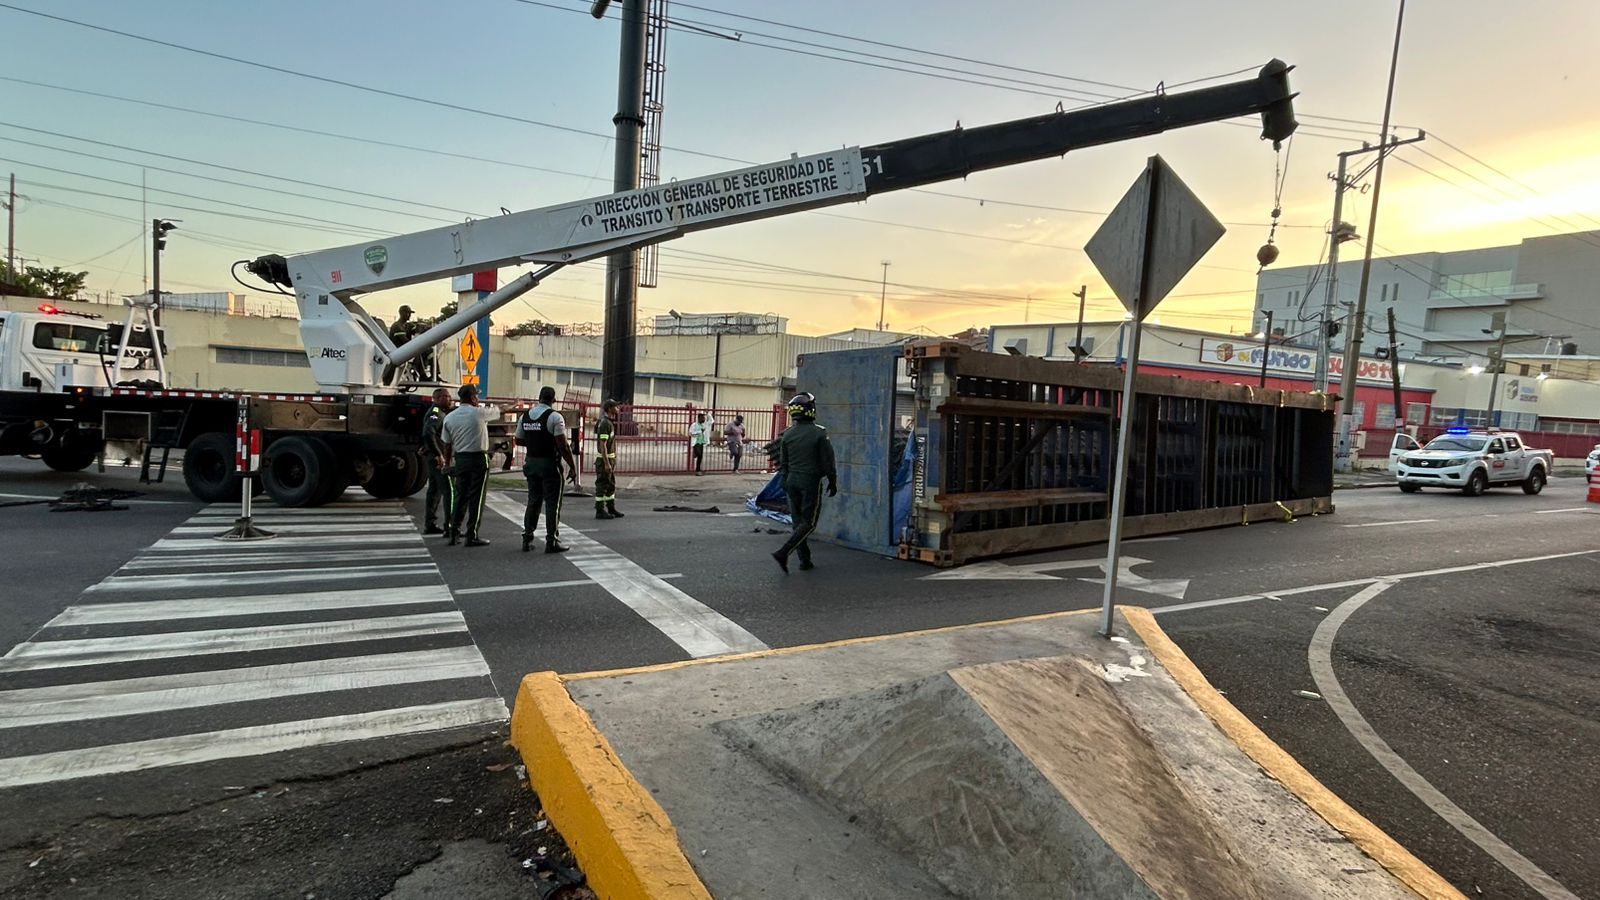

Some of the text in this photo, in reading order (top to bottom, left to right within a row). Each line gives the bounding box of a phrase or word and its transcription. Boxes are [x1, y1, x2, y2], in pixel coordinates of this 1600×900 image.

[664, 181, 720, 204] GENERAL
[723, 175, 740, 191] DE
[743, 162, 814, 188] SEGURIDAD
[817, 157, 835, 174] DE
[602, 175, 838, 233] TRANSITO Y TRANSPORTE TERRESTRE
[331, 270, 342, 283] 911
[321, 347, 346, 358] Altec
